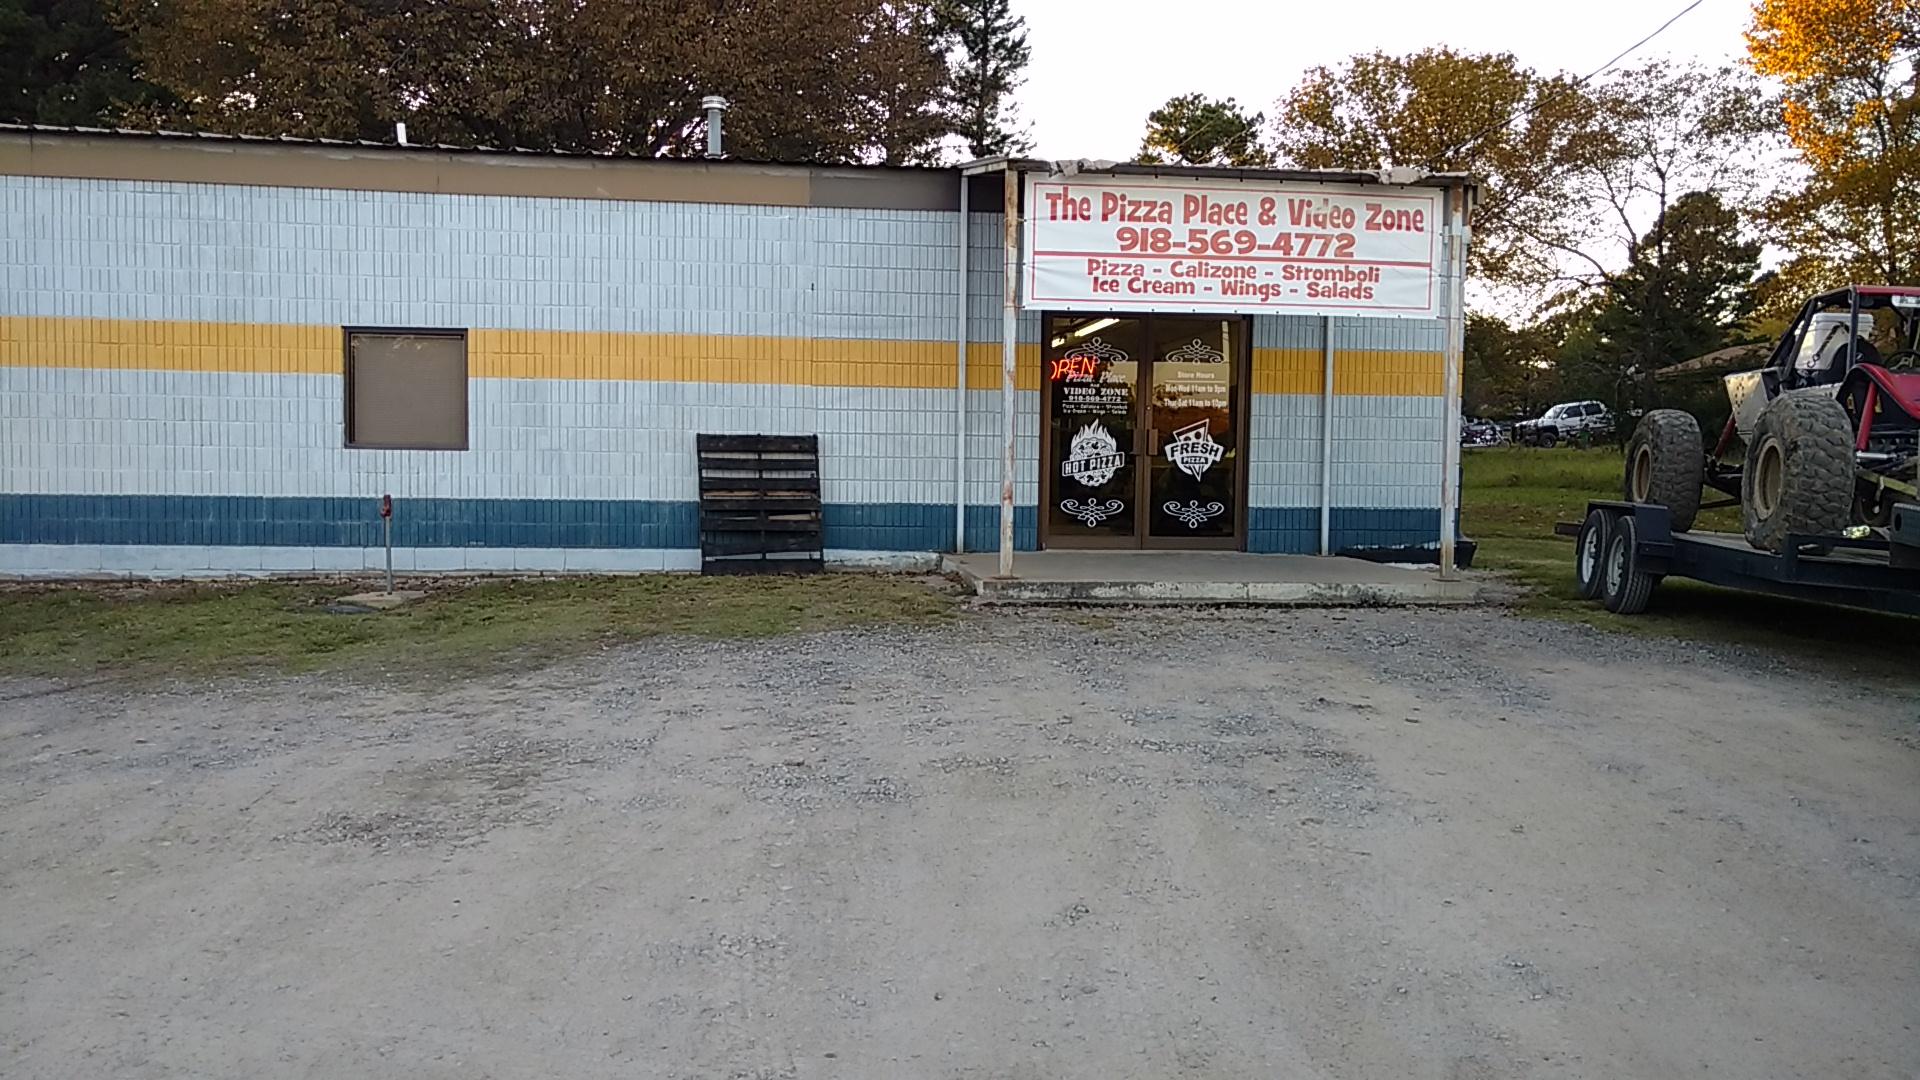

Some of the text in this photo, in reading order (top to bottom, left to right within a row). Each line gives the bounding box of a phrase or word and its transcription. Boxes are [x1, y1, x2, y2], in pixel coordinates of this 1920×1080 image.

[1045, 186, 1425, 233] The Pizza Place & Video Zone
[1116, 226, 1356, 259] 918-569-4772
[1087, 258, 1145, 277] Pizza
[1170, 260, 1257, 281] Calizone
[1281, 264, 1380, 284] Stromboli
[1092, 276, 1120, 294] Ice
[1127, 277, 1195, 295] Cream
[1221, 279, 1281, 302] Wings
[1306, 282, 1374, 300] Salads
[1063, 387, 1129, 396] VIDEO ZONE
[1170, 442, 1219, 457] FRESH
[1065, 454, 1122, 474] HOT PIZZA
